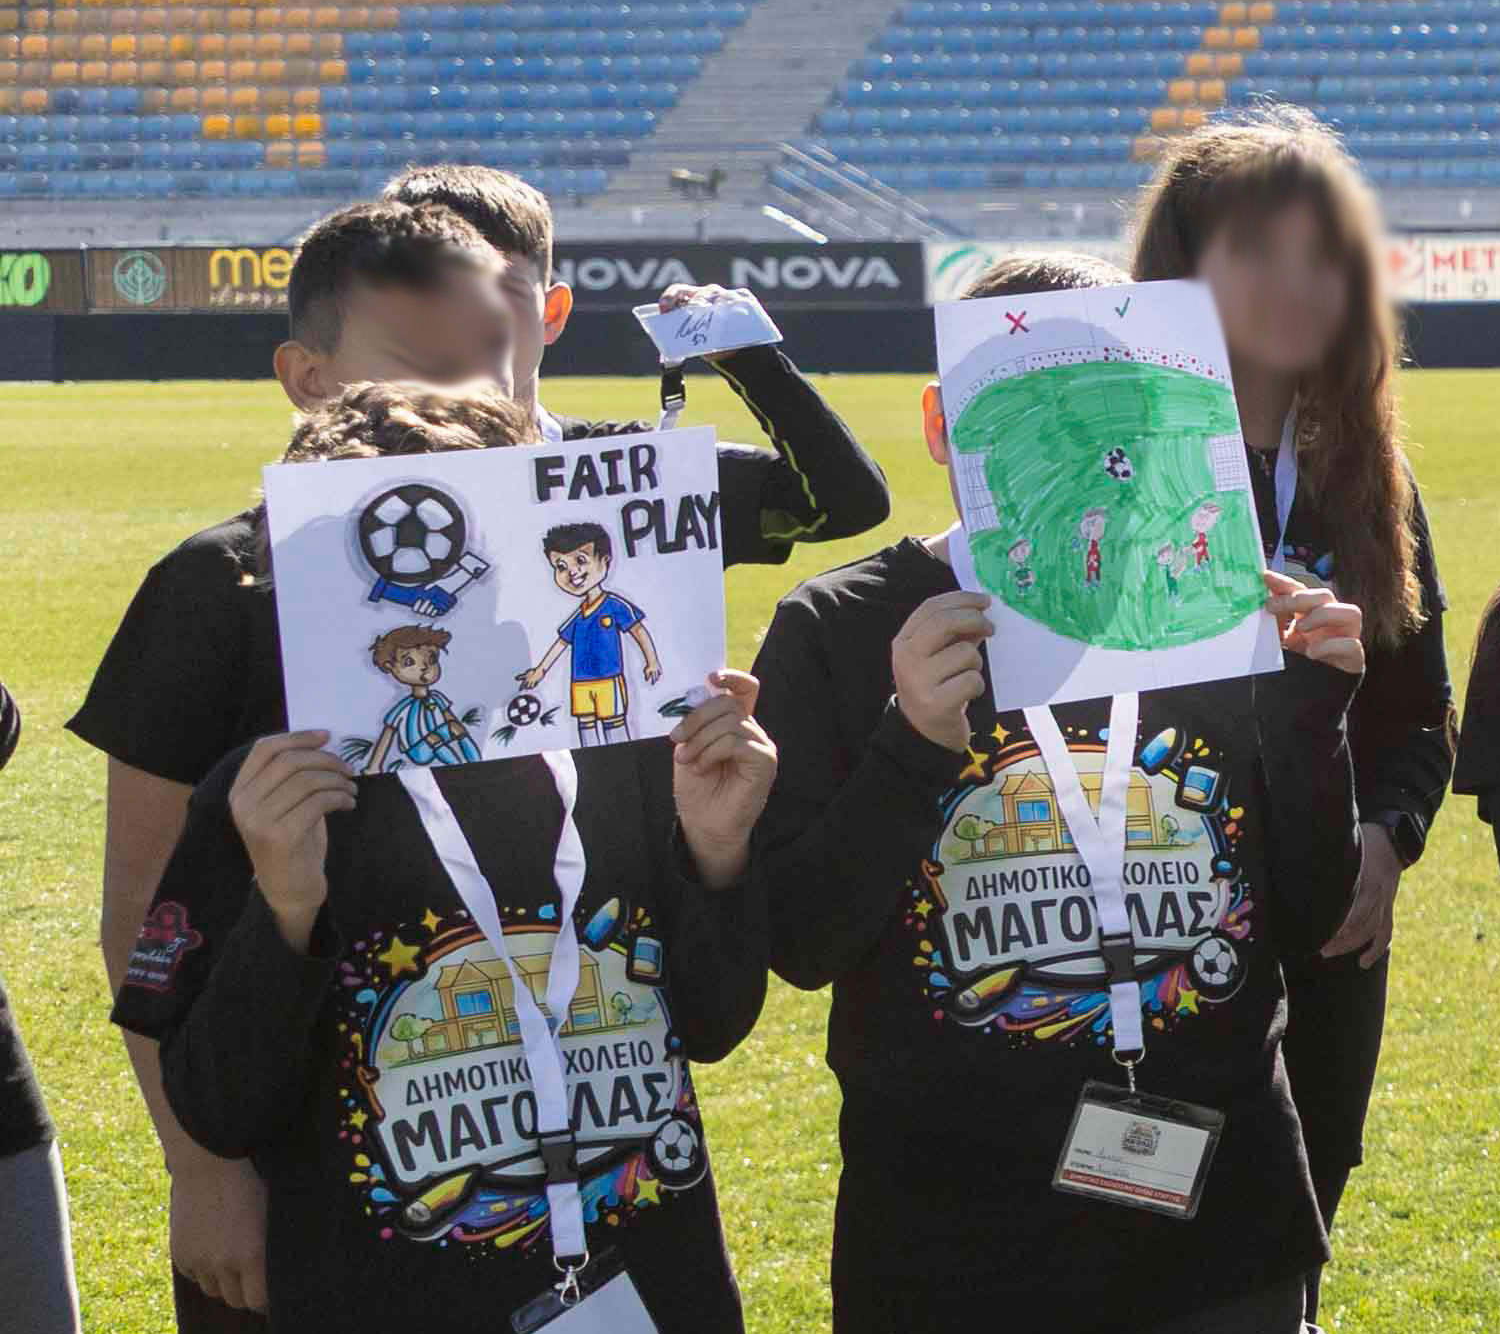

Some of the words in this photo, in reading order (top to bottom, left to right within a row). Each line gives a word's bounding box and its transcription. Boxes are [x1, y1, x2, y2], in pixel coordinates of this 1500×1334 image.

[731, 257, 900, 289] NOVA
[535, 443, 658, 504] FAIR
[620, 491, 720, 559] PLAY
[952, 890, 1213, 963] ΜΑΓΟΛΑΣ
[565, 1039, 654, 1075] ΧΟΛΕΙΟ
[390, 1071, 672, 1172] ΜΑΓΟΛΑΣ
